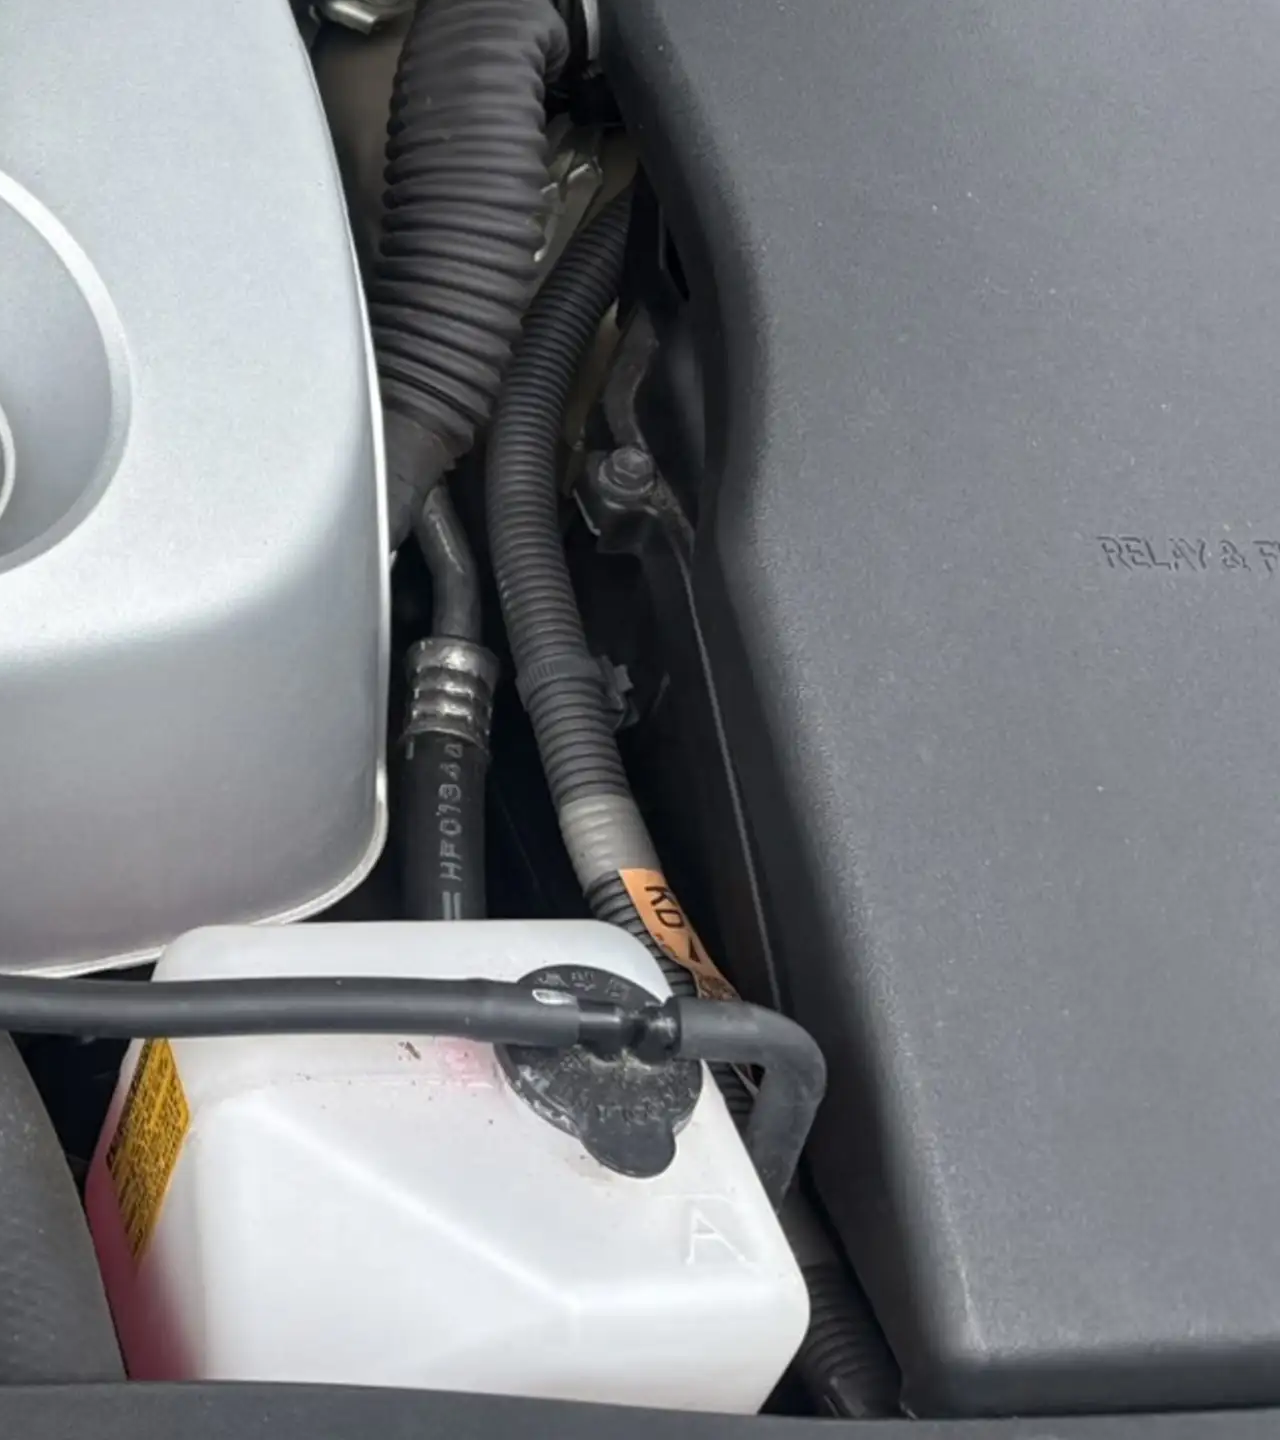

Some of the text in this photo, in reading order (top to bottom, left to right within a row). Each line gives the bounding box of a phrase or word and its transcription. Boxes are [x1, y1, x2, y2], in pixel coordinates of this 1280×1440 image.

[1096, 533, 1280, 576] RELAY & F
